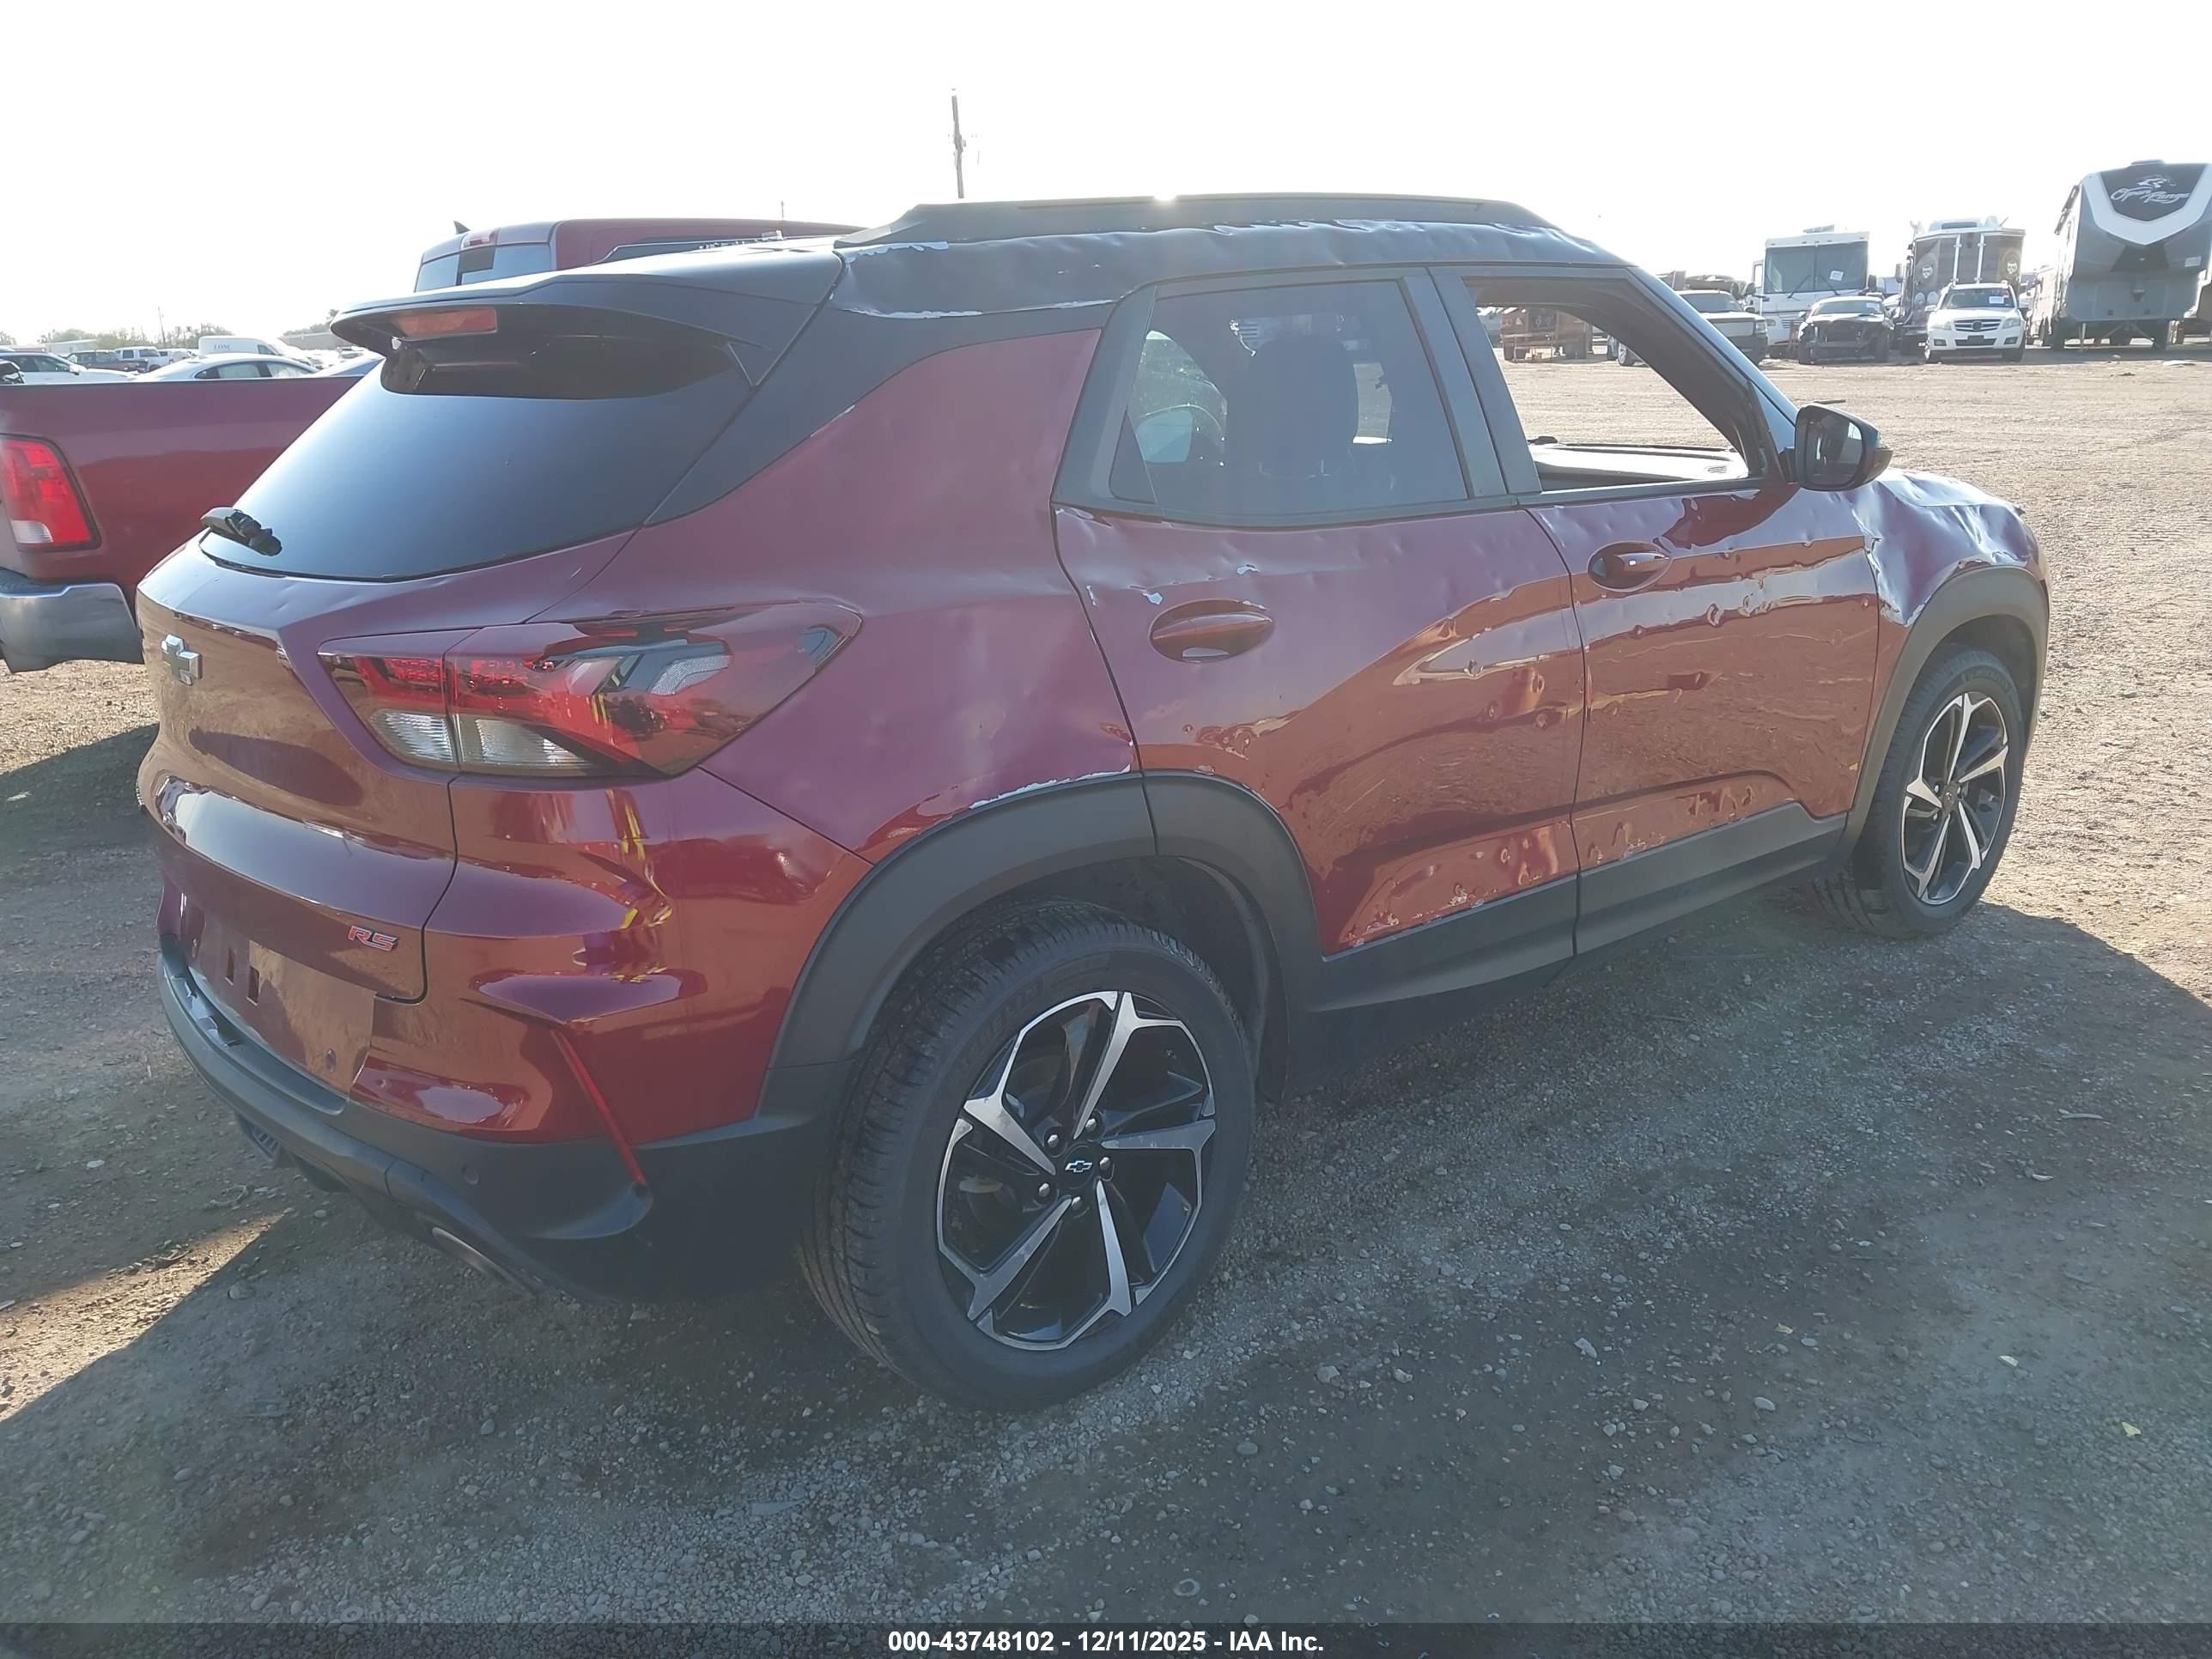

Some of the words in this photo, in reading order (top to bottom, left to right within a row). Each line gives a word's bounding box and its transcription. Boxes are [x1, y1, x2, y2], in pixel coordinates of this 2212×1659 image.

[2111, 185, 2153, 201] Open
[2139, 191, 2191, 204] Range
[348, 926, 398, 951] RS
